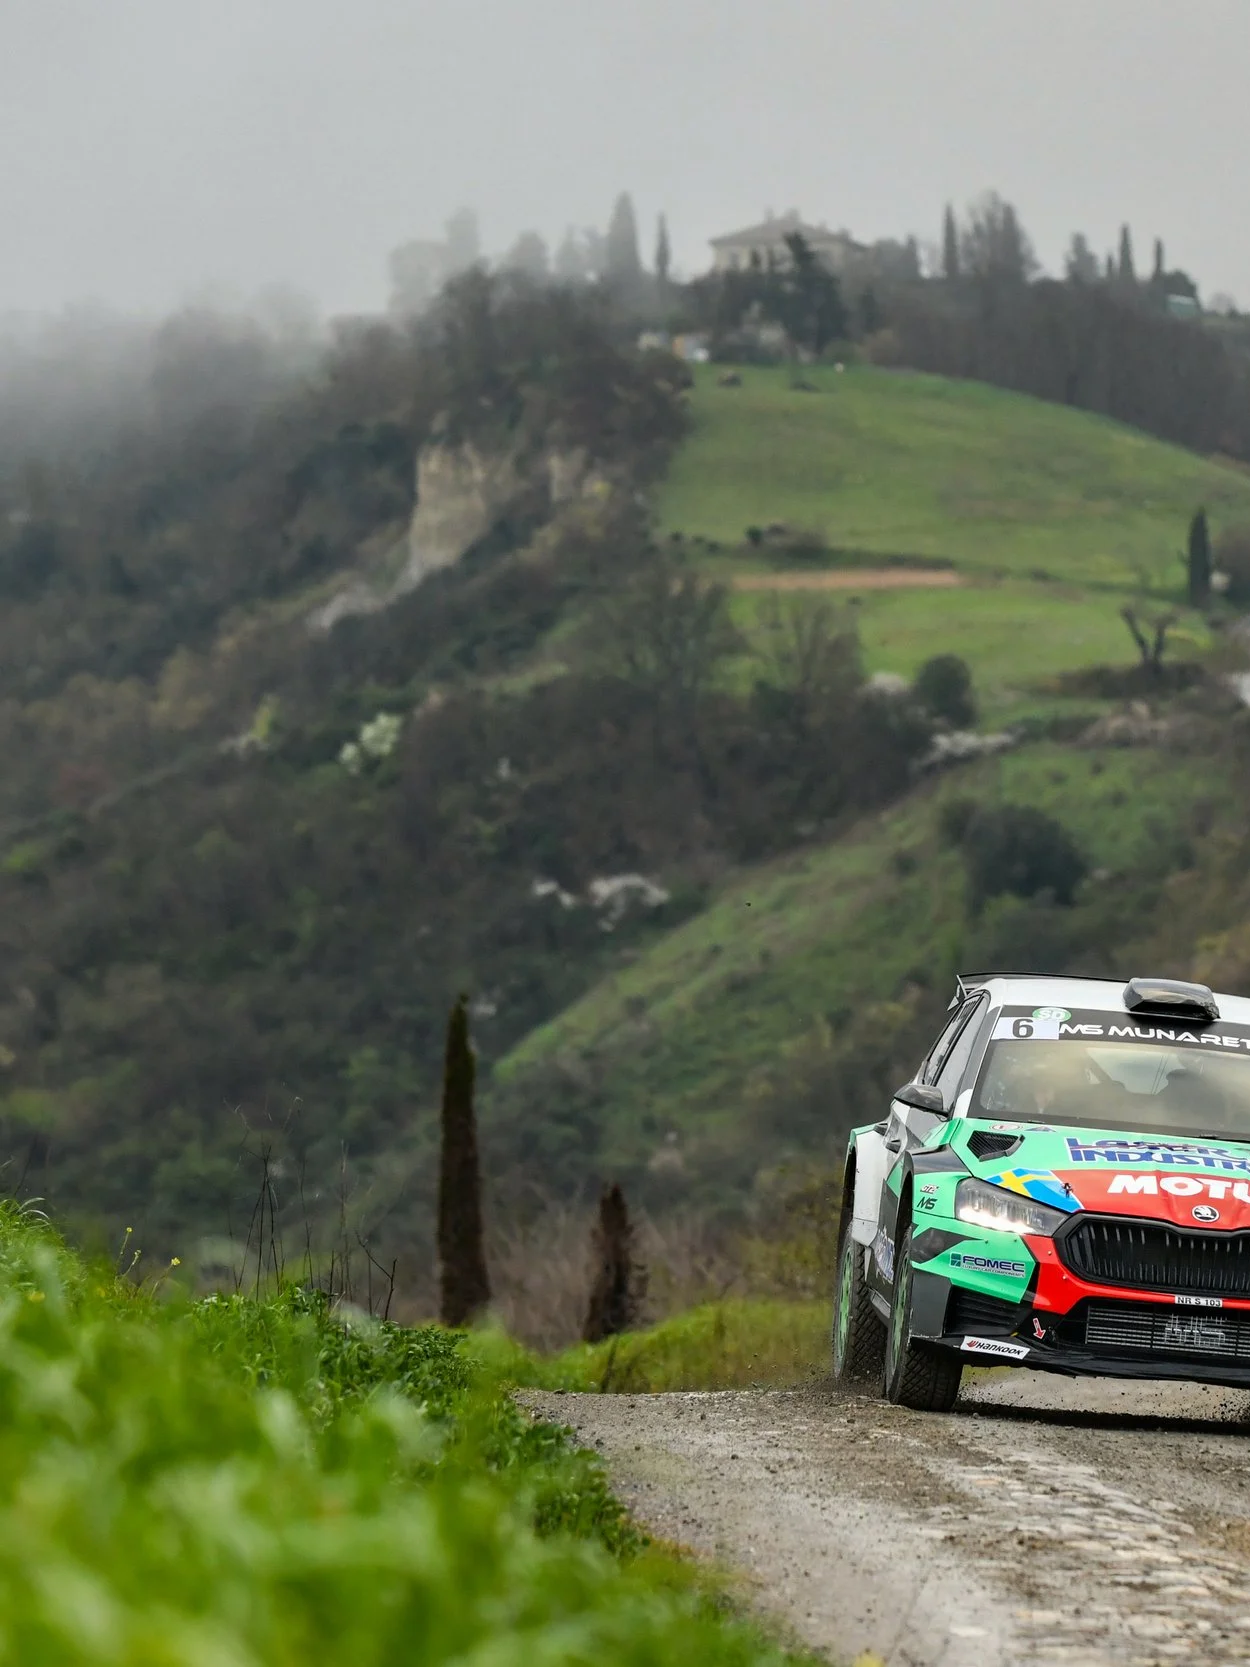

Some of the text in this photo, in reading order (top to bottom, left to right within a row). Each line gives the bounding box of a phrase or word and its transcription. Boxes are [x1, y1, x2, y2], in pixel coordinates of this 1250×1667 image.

[1012, 1018, 1034, 1039] 6
[1059, 1023, 1104, 1036] MS
[963, 1255, 1025, 1272] FOMEC
[1177, 1296, 1221, 1307] NR S 103
